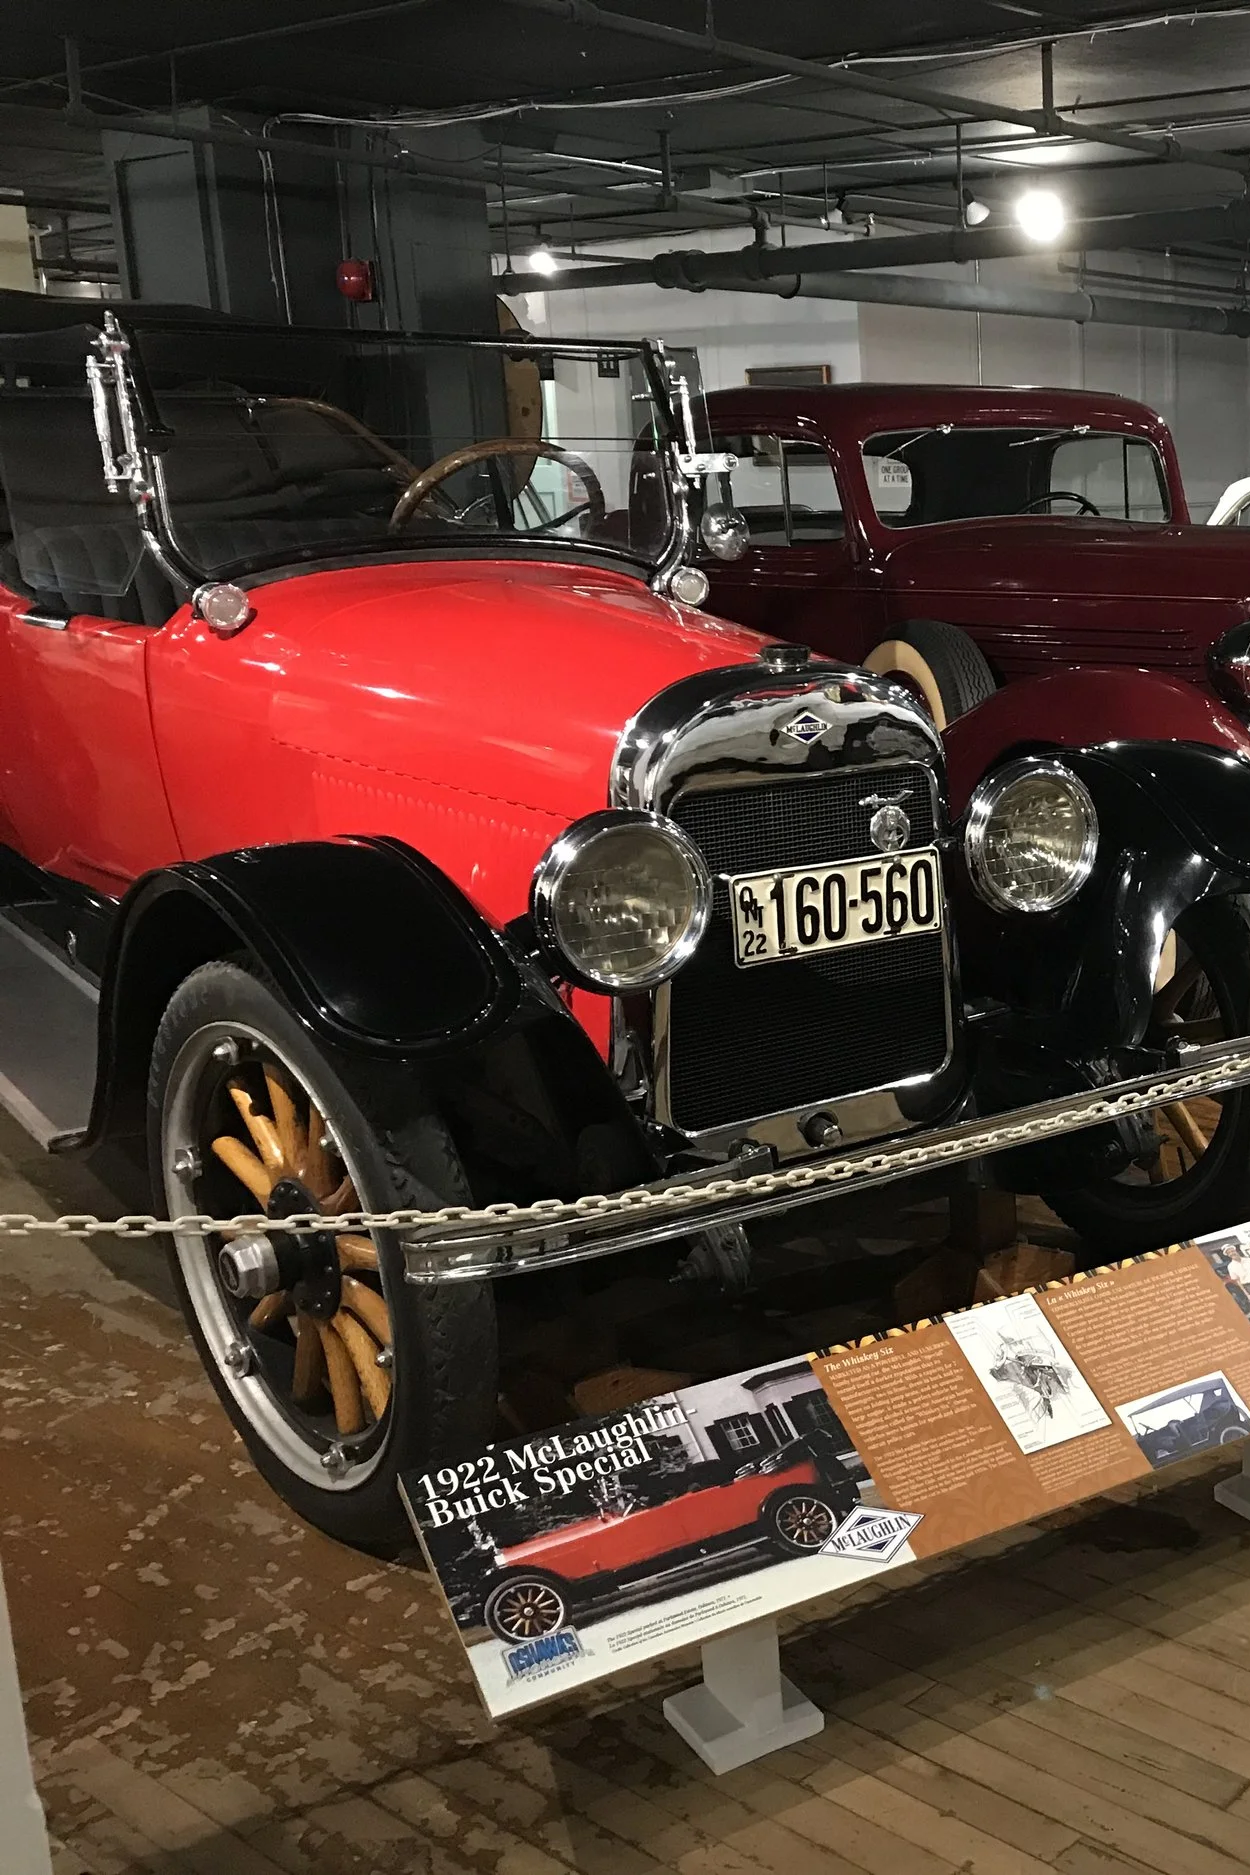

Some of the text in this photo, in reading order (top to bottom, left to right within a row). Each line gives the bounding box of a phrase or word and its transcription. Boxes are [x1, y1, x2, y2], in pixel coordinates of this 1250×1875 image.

[881, 465, 909, 474] ONE GROU
[770, 859, 935, 950] 160-560
[743, 930, 768, 957] 22
[1064, 1284, 1096, 1300] Whiskey
[1096, 1281, 1109, 1290] Six
[824, 1346, 894, 1373] The Whiskey Six
[417, 1403, 698, 1502] 1922 McLaughlin-
[425, 1437, 653, 1528] Buick Special
